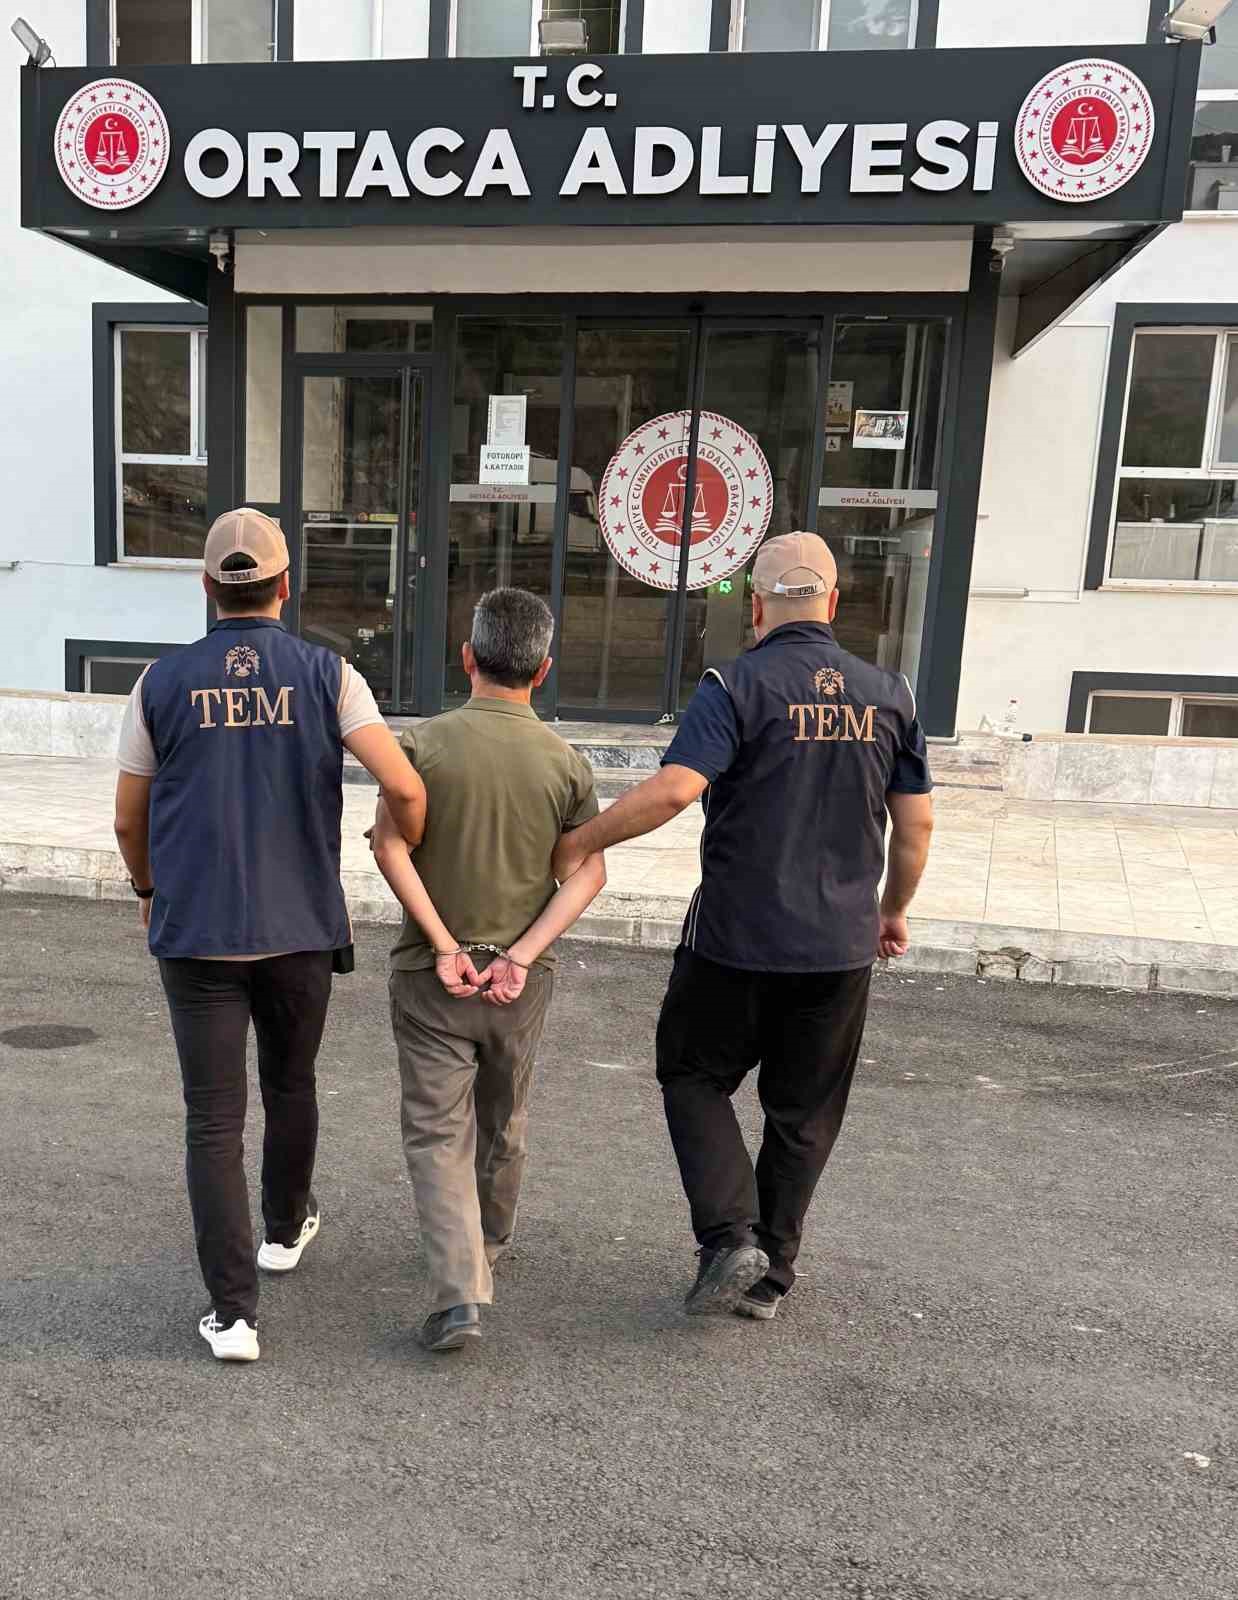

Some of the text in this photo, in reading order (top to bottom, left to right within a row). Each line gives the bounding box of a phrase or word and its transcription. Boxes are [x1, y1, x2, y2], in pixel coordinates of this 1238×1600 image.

[184, 120, 998, 197] ORTACA ADLİYESİ
[698, 447, 735, 480] ADALET
[632, 504, 659, 550] TÜRKİYE
[709, 484, 739, 548] BAKANLIĞI
[191, 686, 295, 729] TEM
[788, 703, 878, 742] TEM
